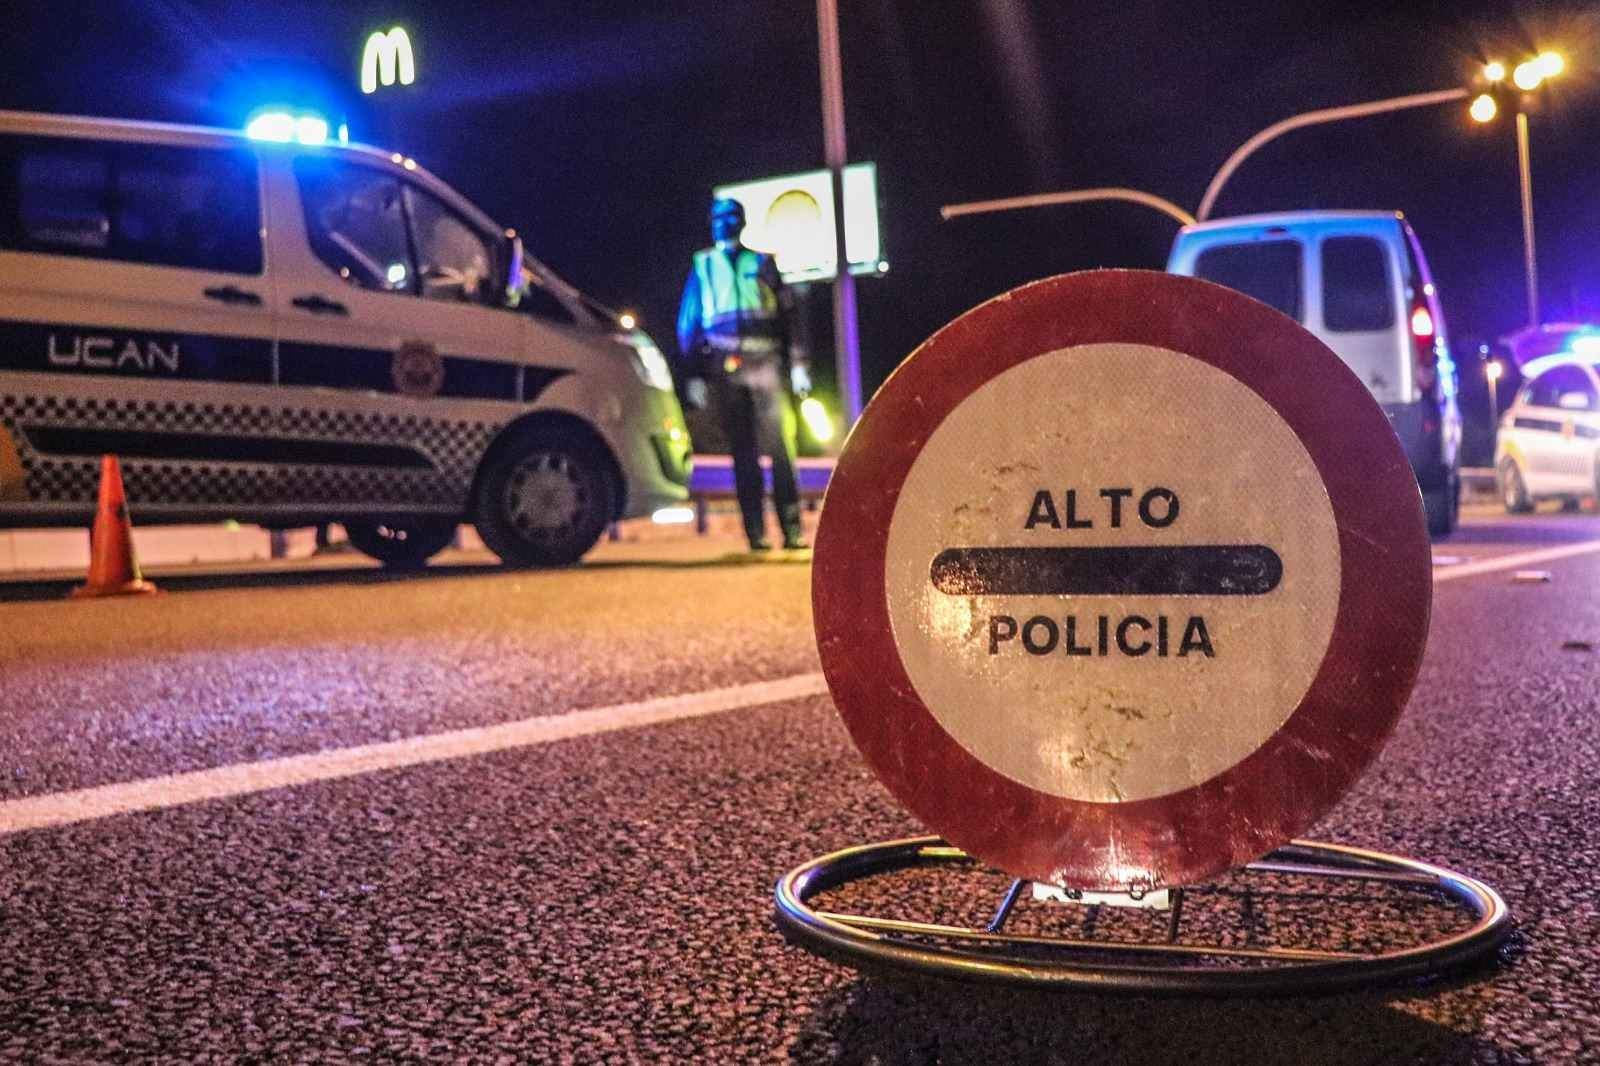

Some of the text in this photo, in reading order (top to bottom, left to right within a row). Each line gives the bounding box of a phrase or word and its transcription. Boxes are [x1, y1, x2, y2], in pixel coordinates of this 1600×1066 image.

[48, 335, 180, 371] UCAN
[1024, 487, 1181, 530] ALTO
[988, 614, 1216, 658] POLICIA
